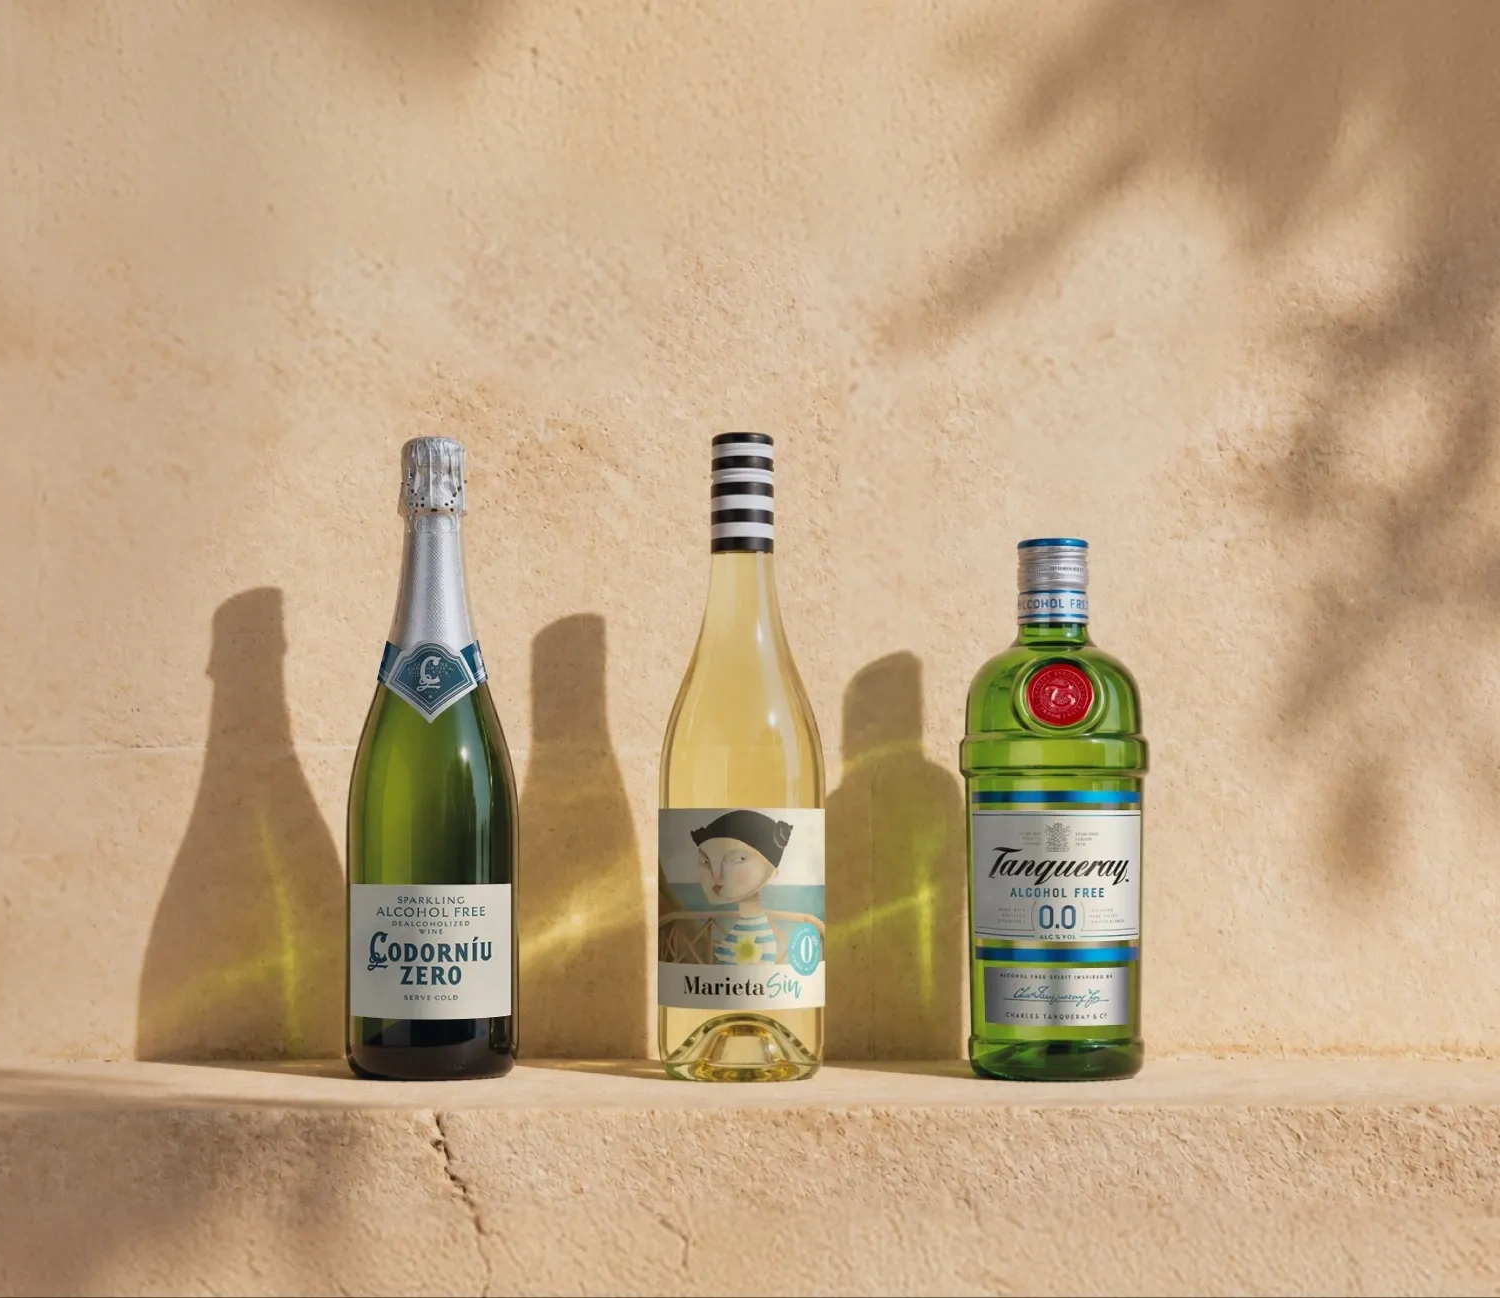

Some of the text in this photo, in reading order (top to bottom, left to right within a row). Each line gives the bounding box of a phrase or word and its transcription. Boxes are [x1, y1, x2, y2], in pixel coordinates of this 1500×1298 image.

[397, 896, 465, 904] SPARKLING
[1010, 887, 1105, 898] ALCOHOL FREE
[376, 906, 486, 917] ALCOHOL FREE
[1038, 904, 1077, 930] 0.0
[367, 931, 492, 971] CODORNÍU
[400, 965, 462, 986] ZERO
[683, 972, 802, 999] Marieta Sin
[1005, 1011, 1039, 1020] CHARLES
[1043, 1012, 1090, 1020] TANQUERAY
